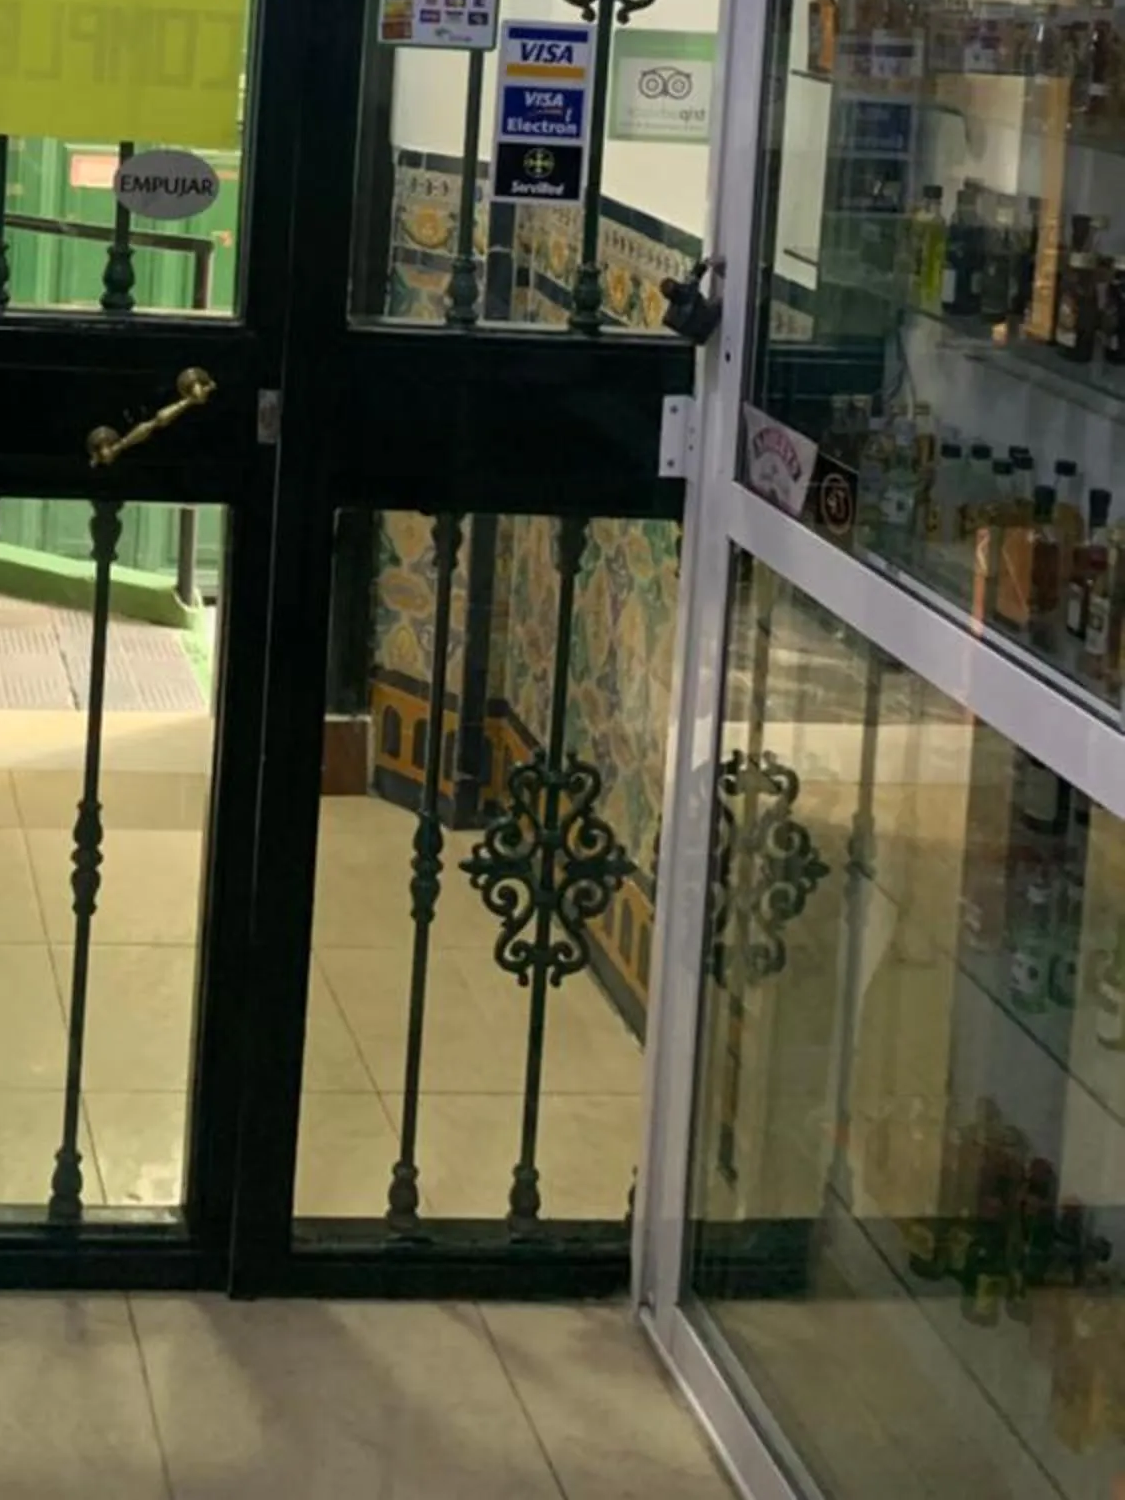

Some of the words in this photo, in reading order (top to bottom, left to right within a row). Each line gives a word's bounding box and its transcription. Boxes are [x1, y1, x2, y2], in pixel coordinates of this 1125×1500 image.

[520, 42, 574, 64] VISA
[524, 90, 564, 107] VISA
[507, 117, 578, 135] Electron
[120, 174, 214, 197] EMPUJAR
